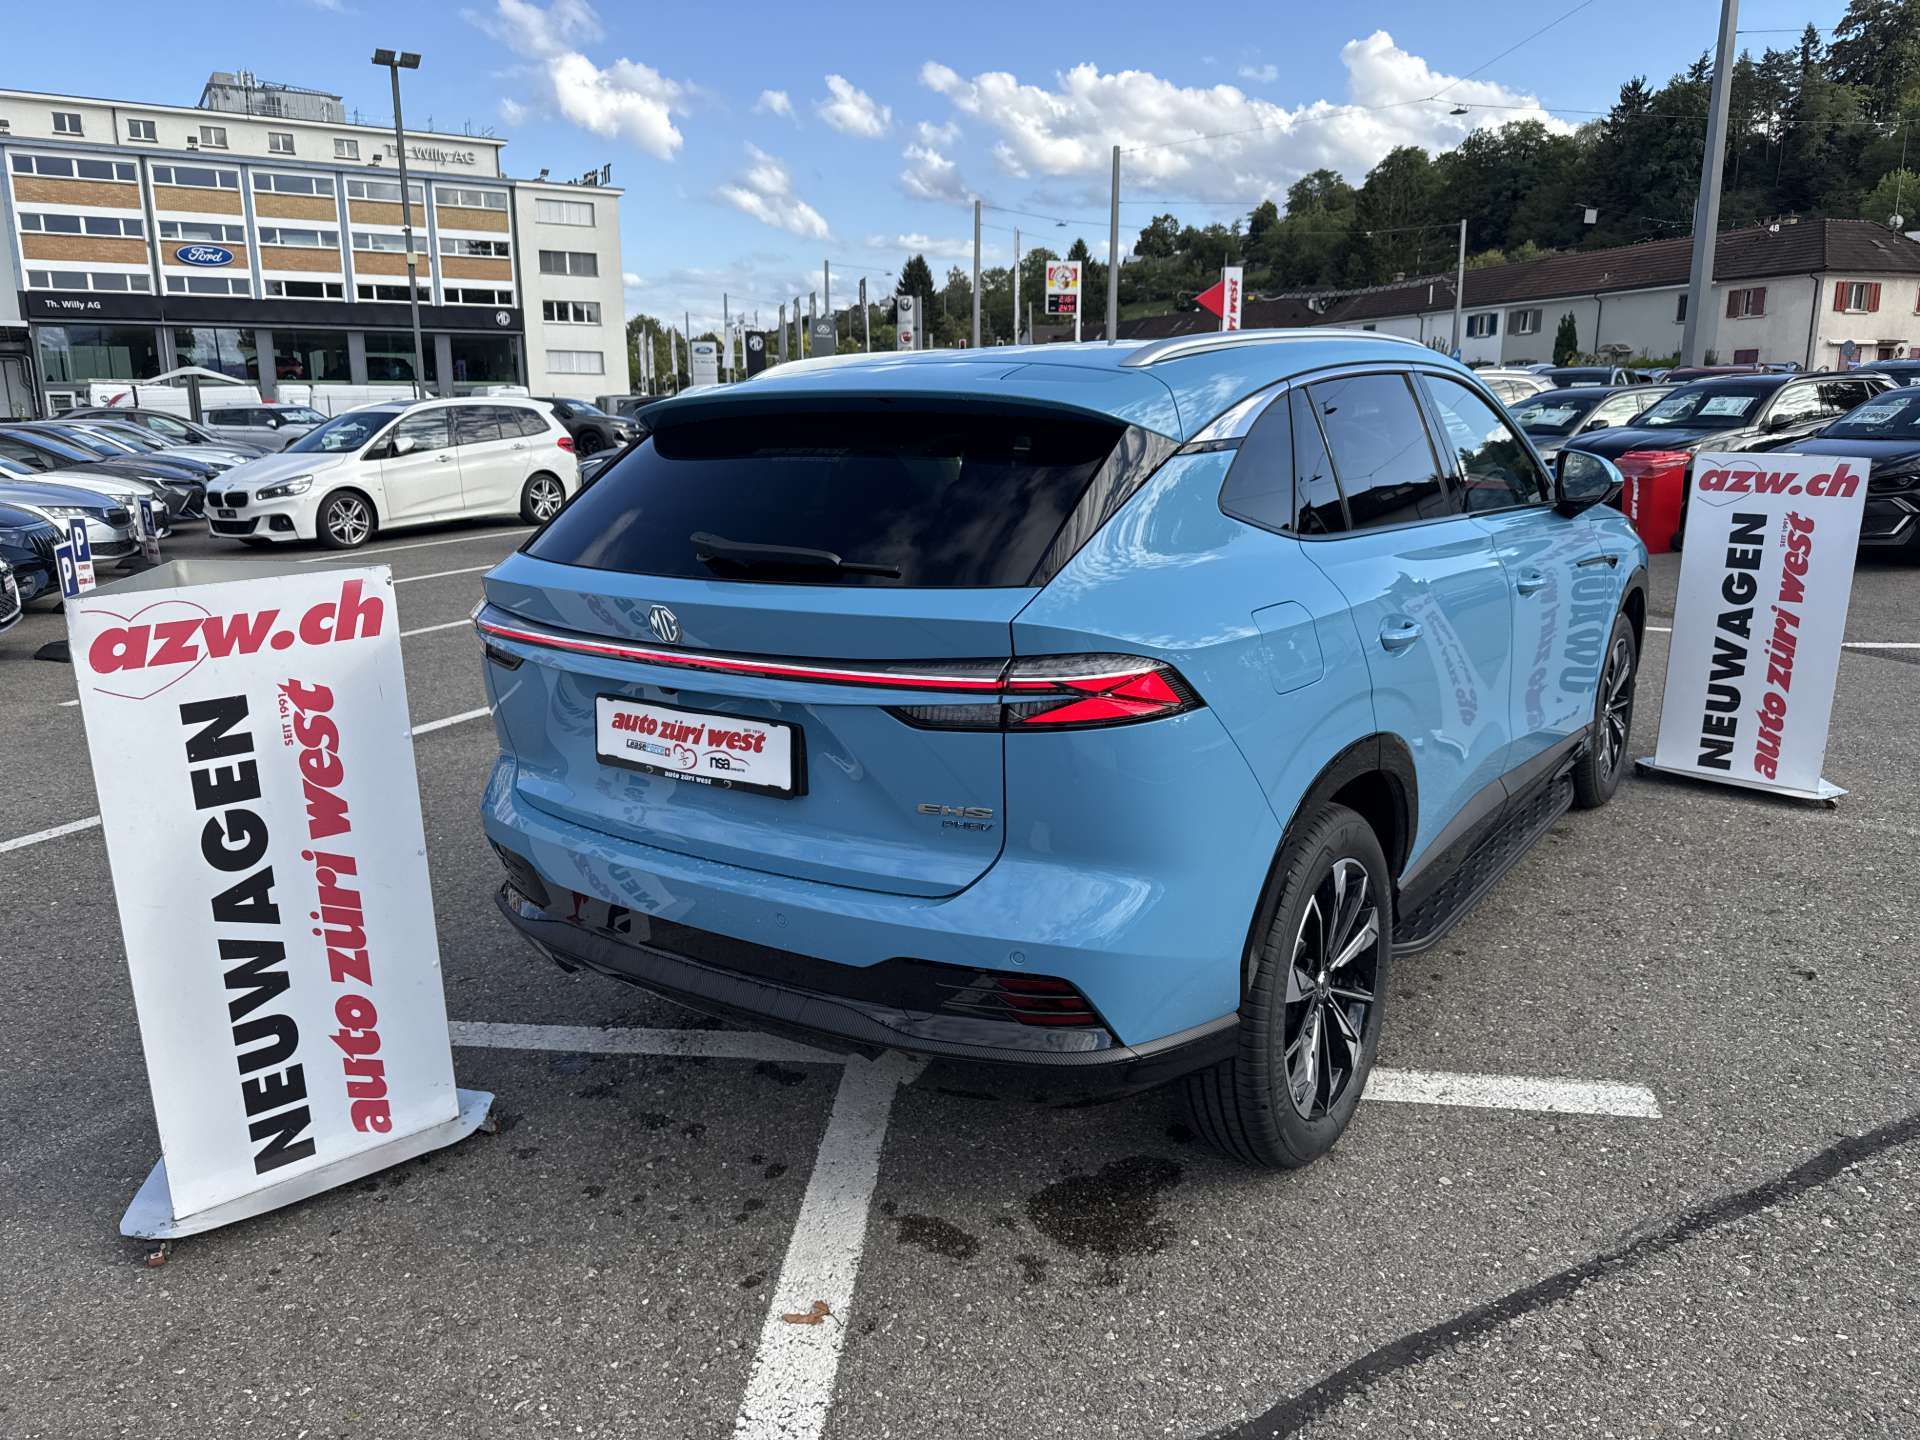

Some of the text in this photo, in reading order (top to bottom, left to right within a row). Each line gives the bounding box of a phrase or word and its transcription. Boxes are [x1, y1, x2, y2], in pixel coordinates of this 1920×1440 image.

[412, 144, 452, 166] Willy
[453, 151, 476, 165] AG
[1769, 224, 1780, 232] 48
[188, 246, 223, 263] Ford
[45, 299, 101, 311] Th. Willy AG
[1698, 463, 1860, 498] azw.ch
[89, 579, 384, 674] azw.ch
[650, 606, 679, 642] MG
[1697, 512, 1768, 771] NEUWAGEN
[1754, 511, 1815, 780] auto züri west
[278, 692, 294, 747] SEIT 1991
[611, 711, 767, 753] auto züri west
[710, 757, 730, 770] nsa
[917, 803, 993, 819] EHS
[942, 820, 993, 832] PHEV
[277, 678, 393, 1134] auto züri west
[179, 694, 316, 1175] NEUWAGEN
